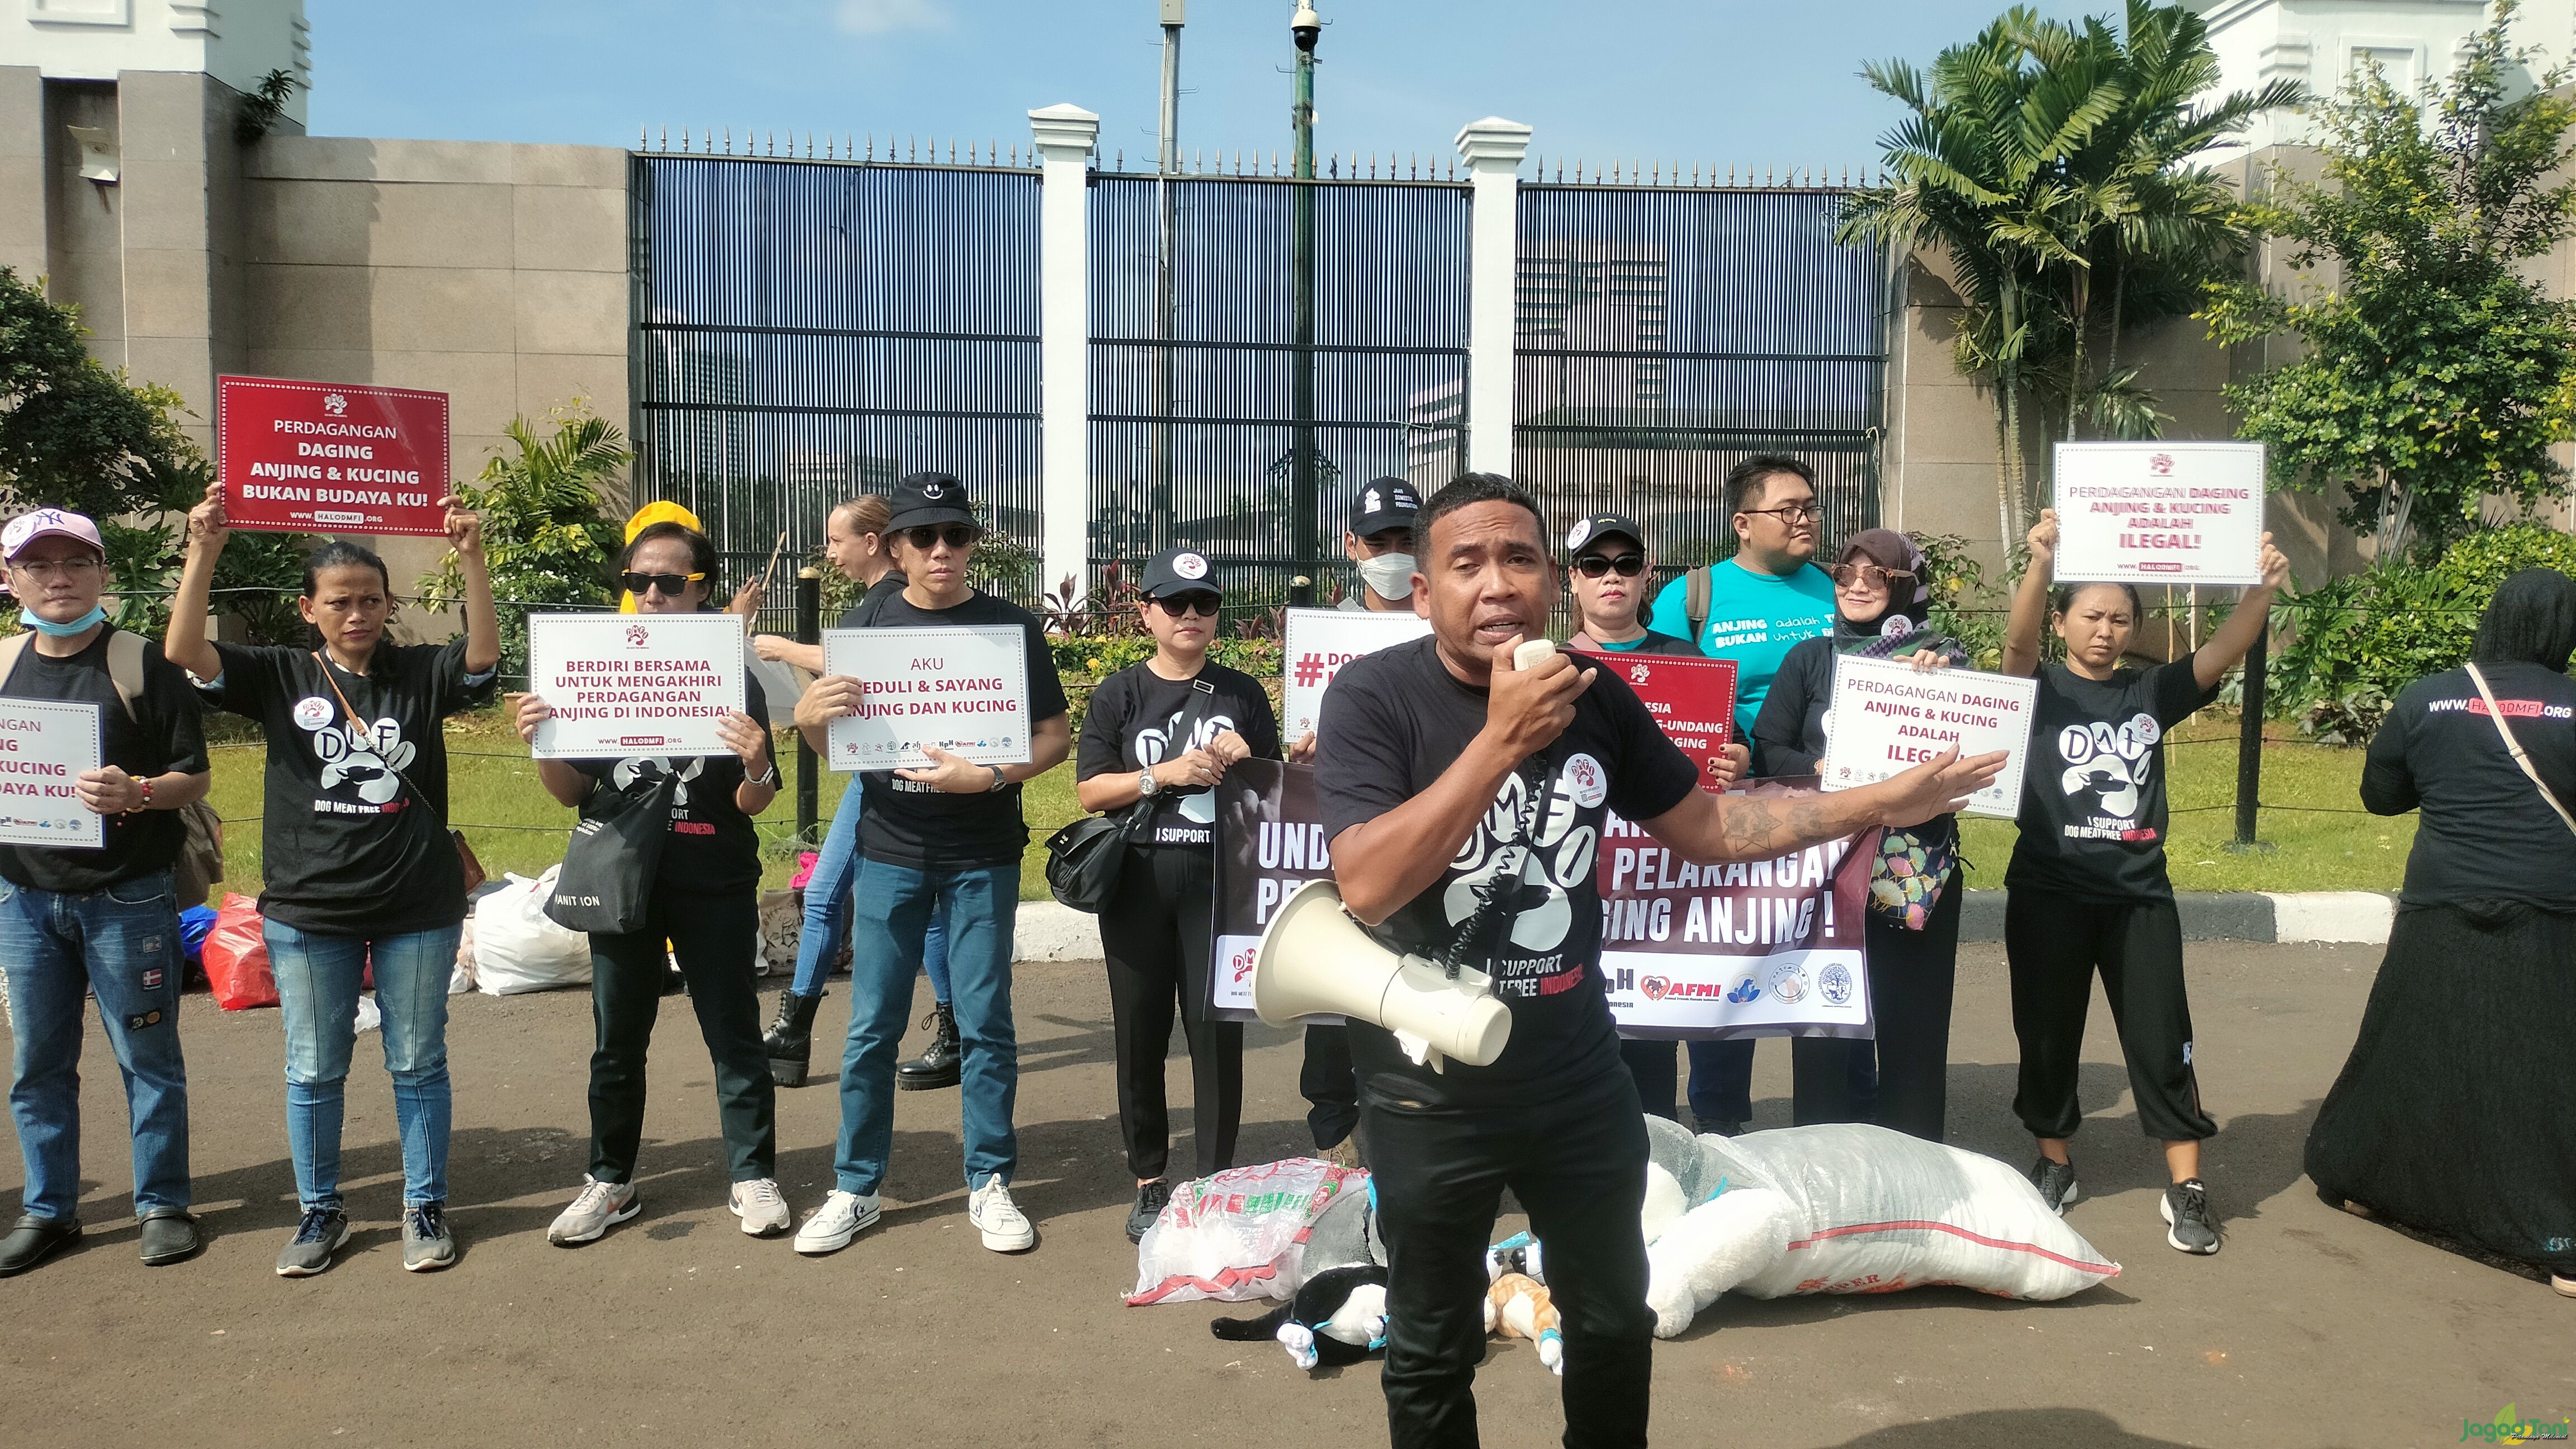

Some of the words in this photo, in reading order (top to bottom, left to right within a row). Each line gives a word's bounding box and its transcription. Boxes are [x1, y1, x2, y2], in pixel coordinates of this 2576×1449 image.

[274, 420, 396, 439] PERDAGANGAN
[298, 443, 373, 459] DAGING
[250, 462, 321, 481] ANJING
[328, 467, 342, 480] &
[347, 469, 419, 484] KUCING
[243, 485, 310, 501] BUKAN
[316, 489, 392, 505] BUDAYA
[397, 493, 428, 506] KU!
[2070, 486, 2186, 499] PERDAGANGAN
[2189, 487, 2249, 499] DAGING
[2090, 502, 2151, 515] ANJING
[2152, 503, 2167, 514] &
[2169, 503, 2231, 514] KUCING
[2127, 518, 2194, 529] ADALAH
[2119, 534, 2201, 549] ILEGAL!
[1711, 619, 1768, 634] ANJING
[1775, 615, 1821, 627] adalah
[1715, 632, 1768, 648] BUKAN
[566, 661, 629, 672] BERDIRI
[634, 660, 711, 671] BERSAMA
[911, 657, 944, 670] AKU
[556, 676, 613, 687] UNTUK
[618, 675, 722, 687] MENGAKHIRI
[863, 680, 912, 694] EDULI
[918, 680, 930, 693] &
[935, 678, 1003, 692] SAYANG
[577, 691, 701, 703] PERDAGANGAN
[1848, 679, 1957, 703] PERDAGANGAN
[1962, 694, 2020, 712] DAGING
[549, 707, 609, 721] ANJING
[614, 707, 630, 718] DI
[636, 706, 730, 718] INDONESIA!
[840, 703, 904, 720] NJING
[910, 702, 946, 715] DAN
[952, 699, 1017, 713] KUCING
[1645, 702, 1671, 713] ESIA
[1864, 700, 1920, 718] ANJING
[1925, 708, 1935, 719] &
[1940, 710, 1998, 728] KUCING
[2429, 699, 2572, 718] WWW.HAODMFI.ORG
[1655, 719, 1723, 733] G-UNDANG
[1898, 724, 1960, 742] ADALAH
[1888, 745, 1964, 764] ILEG
[45, 785, 76, 798] KU!
[892, 779, 903, 792] DOG
[905, 780, 926, 793] MEAT
[315, 800, 332, 812] DOG
[334, 802, 357, 814] MEAT
[675, 821, 715, 835] INDONESIA
[2064, 825, 2078, 837] DOG
[2087, 816, 2092, 826] I
[2092, 817, 2135, 831] SUPPORT
[1156, 827, 1161, 841] I
[1161, 827, 1210, 842] SUPPORT
[1258, 822, 1334, 870] UND
[1683, 897, 1815, 945] ANJING
[1670, 983, 1721, 997] AFMI
